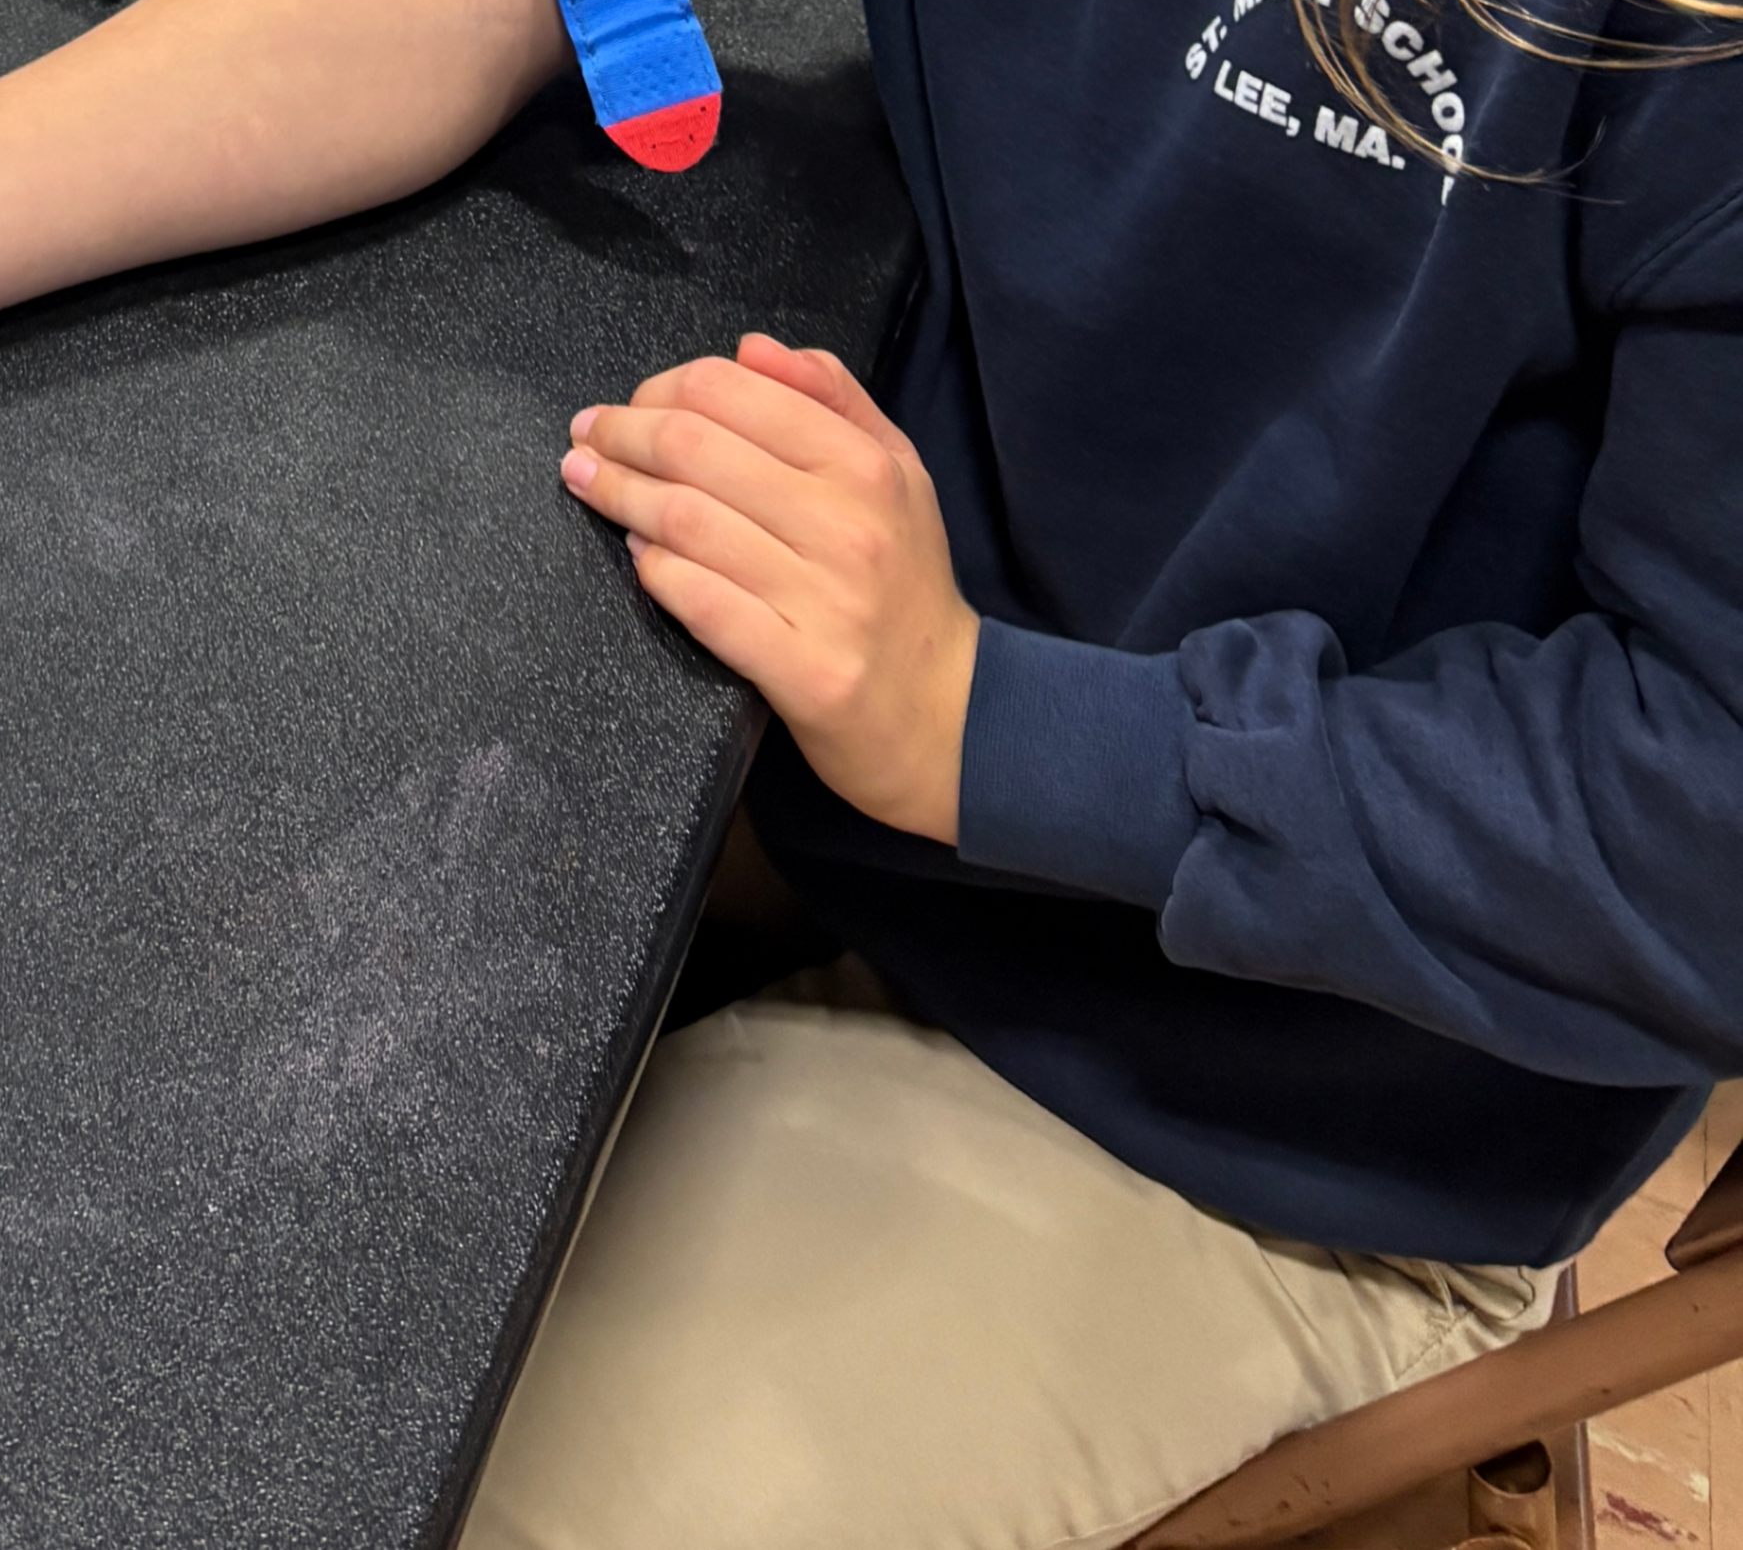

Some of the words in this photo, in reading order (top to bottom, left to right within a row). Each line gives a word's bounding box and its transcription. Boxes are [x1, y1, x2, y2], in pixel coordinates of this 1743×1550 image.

[1184, 15, 1228, 80] ST.
[1213, 59, 1302, 138] LEE,
[1313, 104, 1406, 171] MA.
